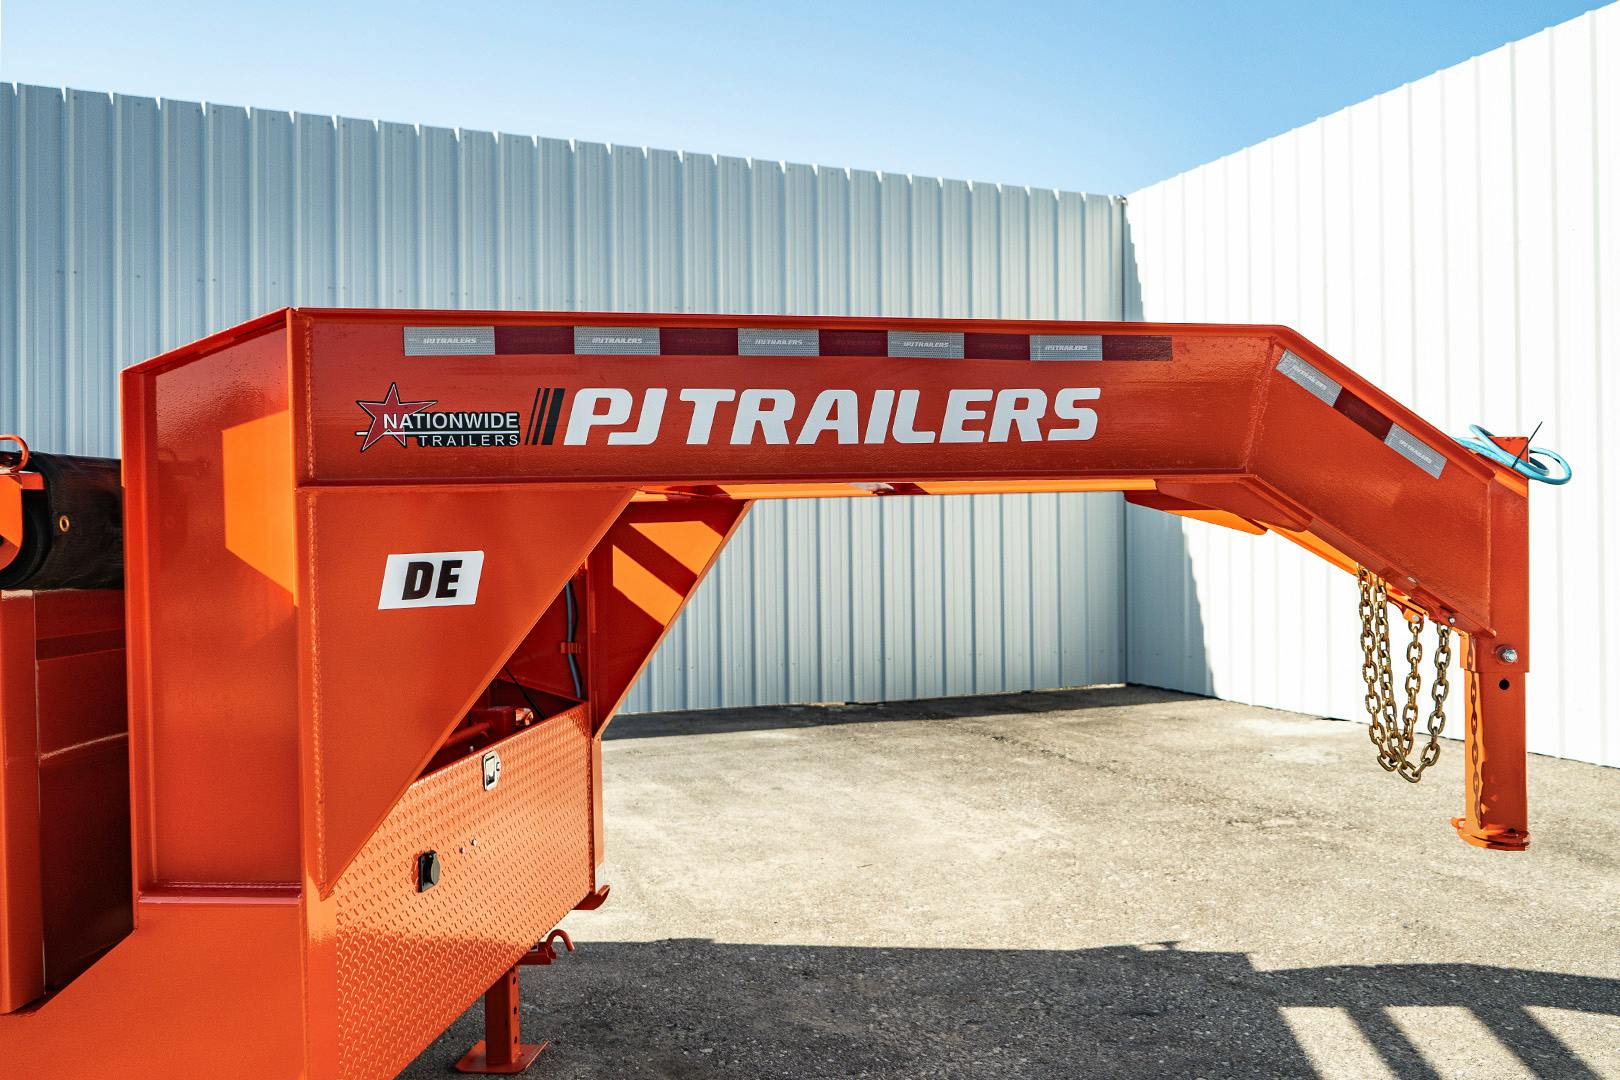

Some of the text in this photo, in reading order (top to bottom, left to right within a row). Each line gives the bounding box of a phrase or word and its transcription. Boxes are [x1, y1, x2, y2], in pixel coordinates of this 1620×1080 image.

[383, 413, 519, 429] NATIONWIDE
[564, 387, 1102, 446] PJ TRAILERS
[419, 435, 519, 447] TRAILERS
[402, 560, 463, 600] DE
